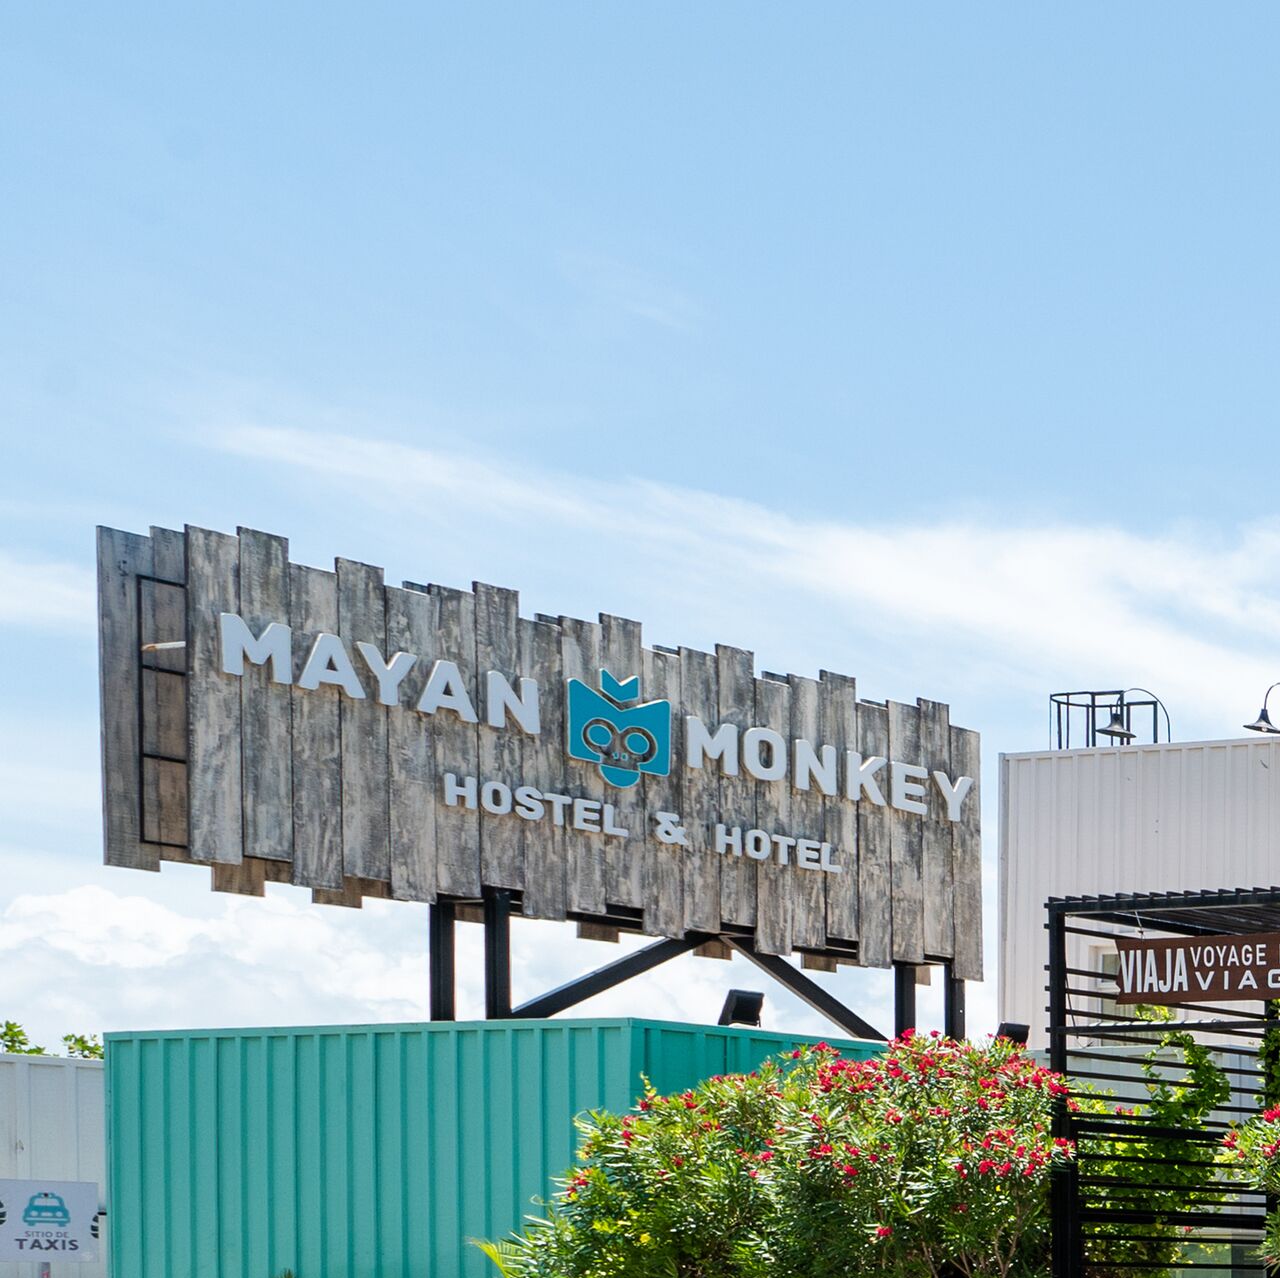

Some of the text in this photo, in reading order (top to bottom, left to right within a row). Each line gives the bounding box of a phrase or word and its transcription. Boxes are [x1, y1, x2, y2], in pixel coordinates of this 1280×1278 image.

[219, 612, 974, 823] MAYAN MONKEY
[443, 772, 842, 874] HOSTEL & HOTEL
[1119, 947, 1189, 994] VIAJA
[1189, 943, 1267, 968] VOYAGE
[14, 1238, 80, 1251] TAXIS
[24, 1230, 70, 1239] SITIO DE
